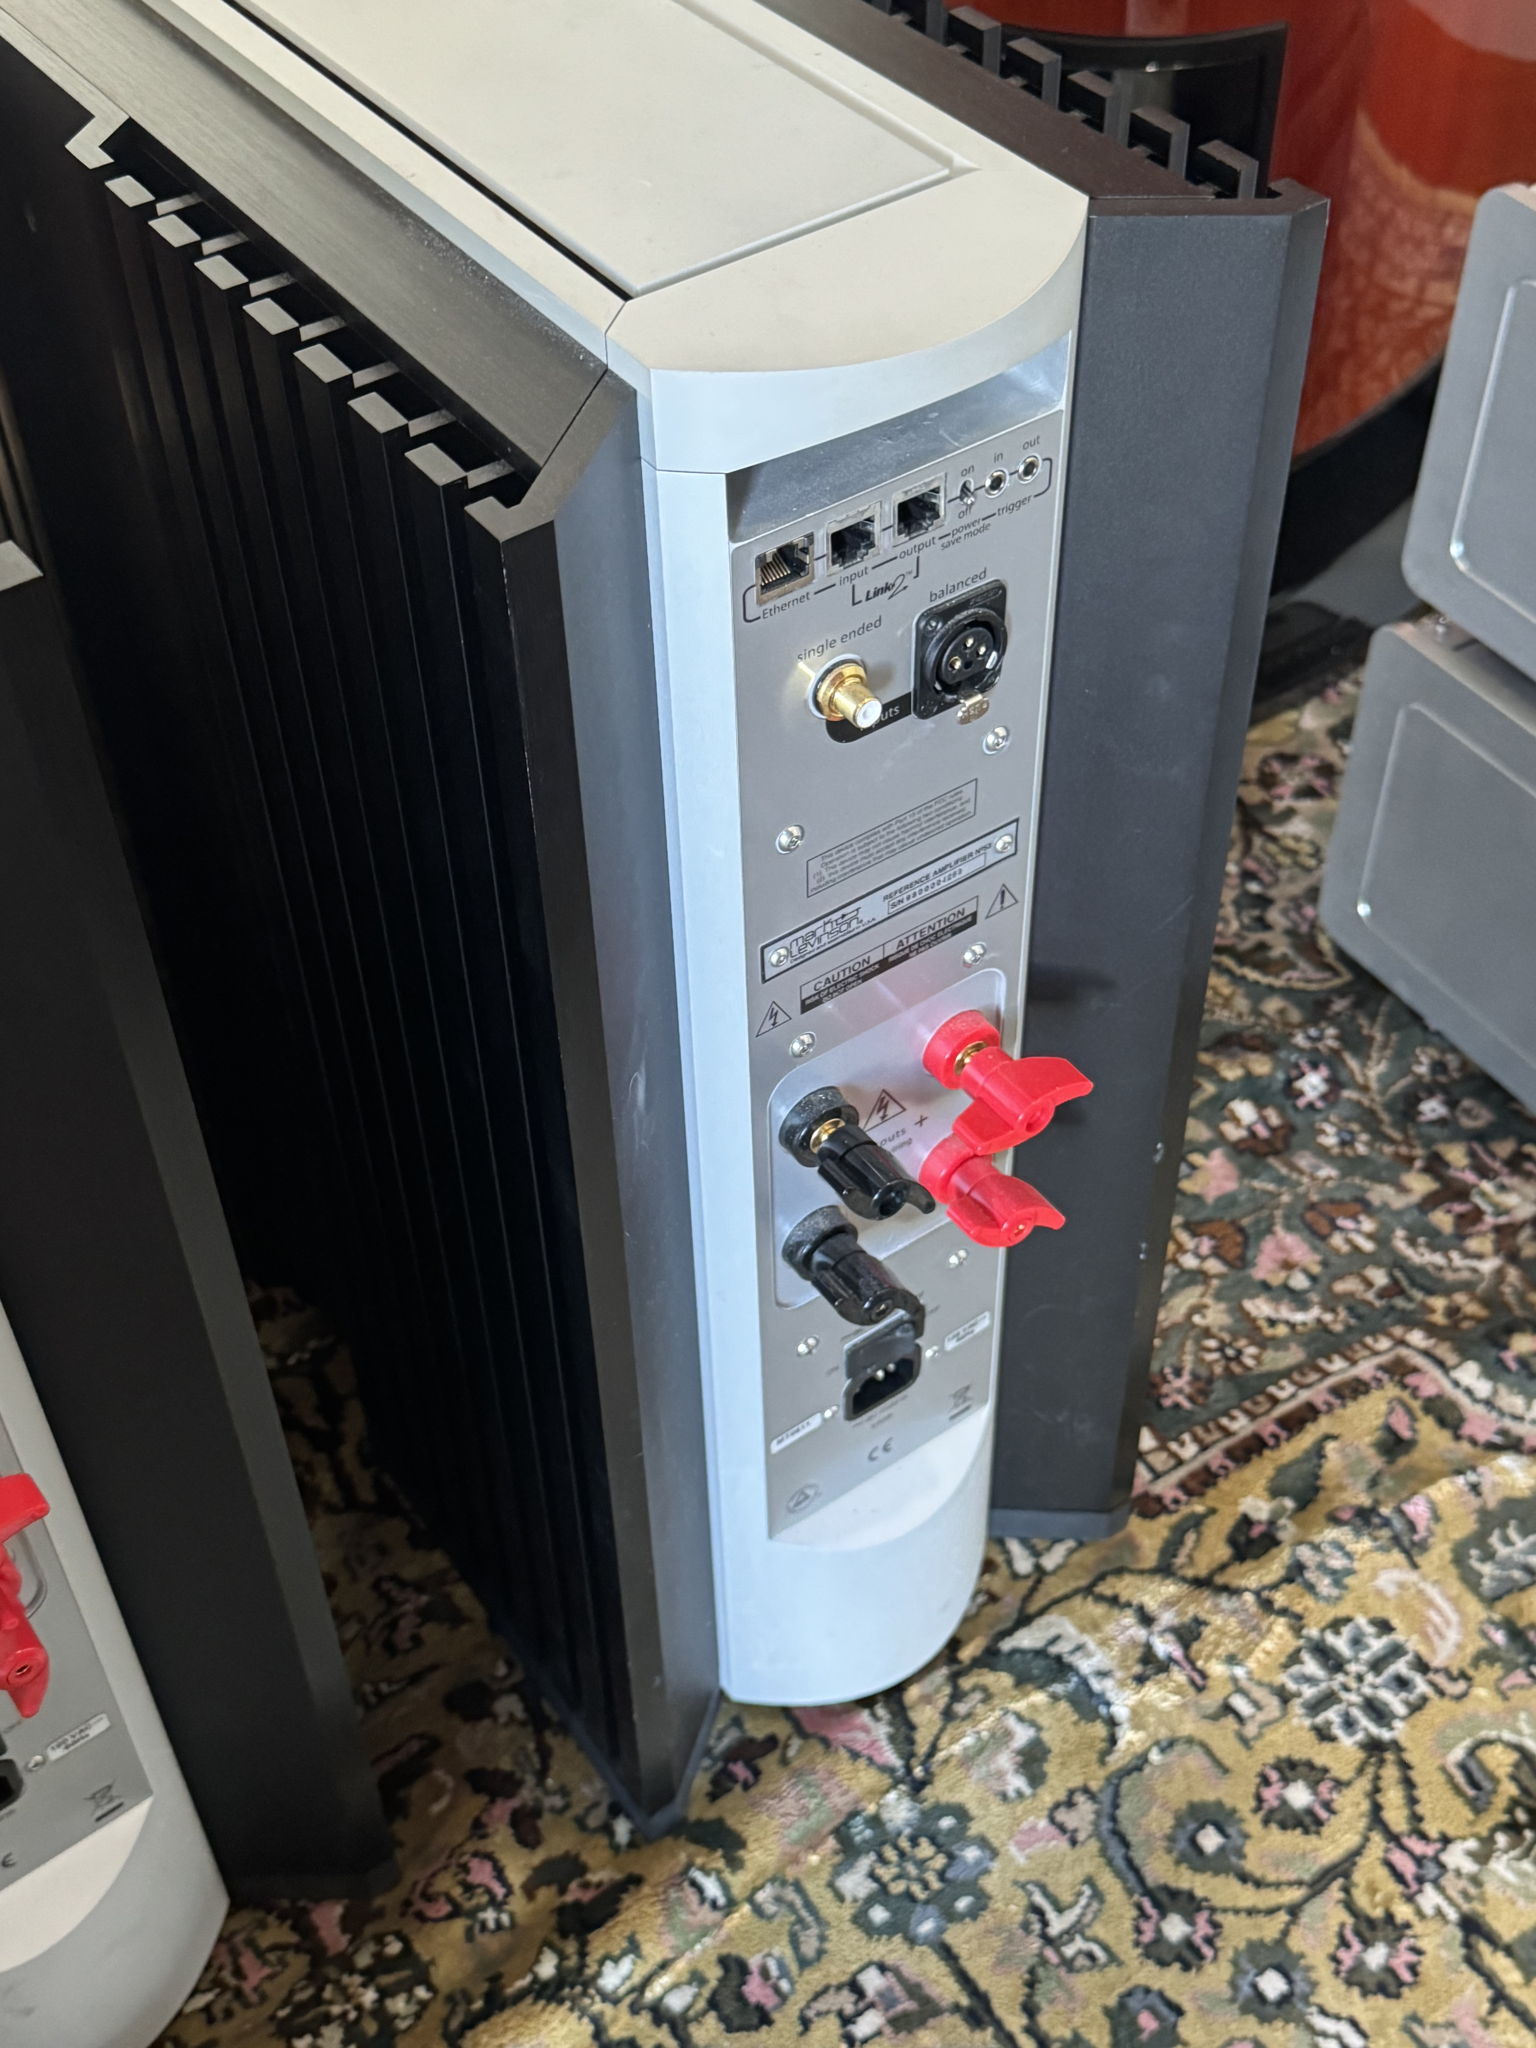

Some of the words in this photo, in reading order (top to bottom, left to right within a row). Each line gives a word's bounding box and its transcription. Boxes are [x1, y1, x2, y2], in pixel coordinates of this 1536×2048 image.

[1022, 435, 1040, 451] out
[994, 452, 1003, 463] in
[961, 465, 975, 477] on
[958, 505, 973, 519] off
[997, 495, 1032, 516] trigger
[941, 536, 962, 551] save
[963, 522, 991, 539] mode
[951, 518, 981, 538] power
[899, 537, 936, 560] output
[839, 566, 869, 586] input
[929, 567, 987, 602] balanced
[762, 592, 810, 619] Ethernet
[797, 638, 837, 660] single
[840, 615, 882, 643] ended
[883, 873, 930, 902] REFERENCE
[932, 852, 974, 877] AMPLIFIER
[896, 908, 966, 949] ATTENTION
[813, 956, 871, 992] CAUTION
